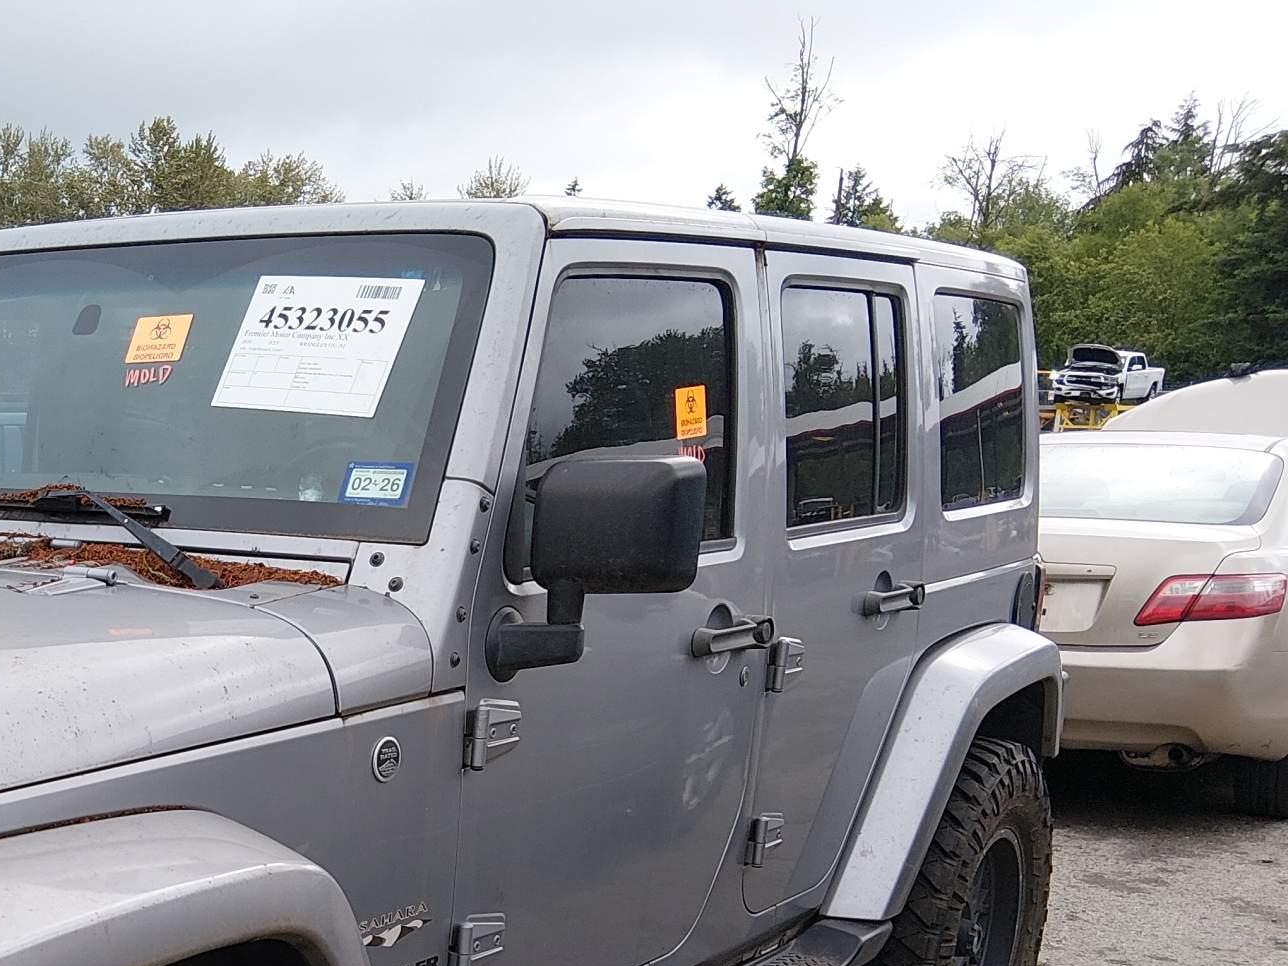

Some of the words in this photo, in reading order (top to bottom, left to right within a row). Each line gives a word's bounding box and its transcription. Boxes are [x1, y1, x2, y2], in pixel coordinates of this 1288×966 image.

[258, 305, 391, 334] 45323055
[136, 343, 177, 352] BIOHAZARD
[125, 365, 173, 387] MOLD
[359, 900, 429, 933] SAHARA
